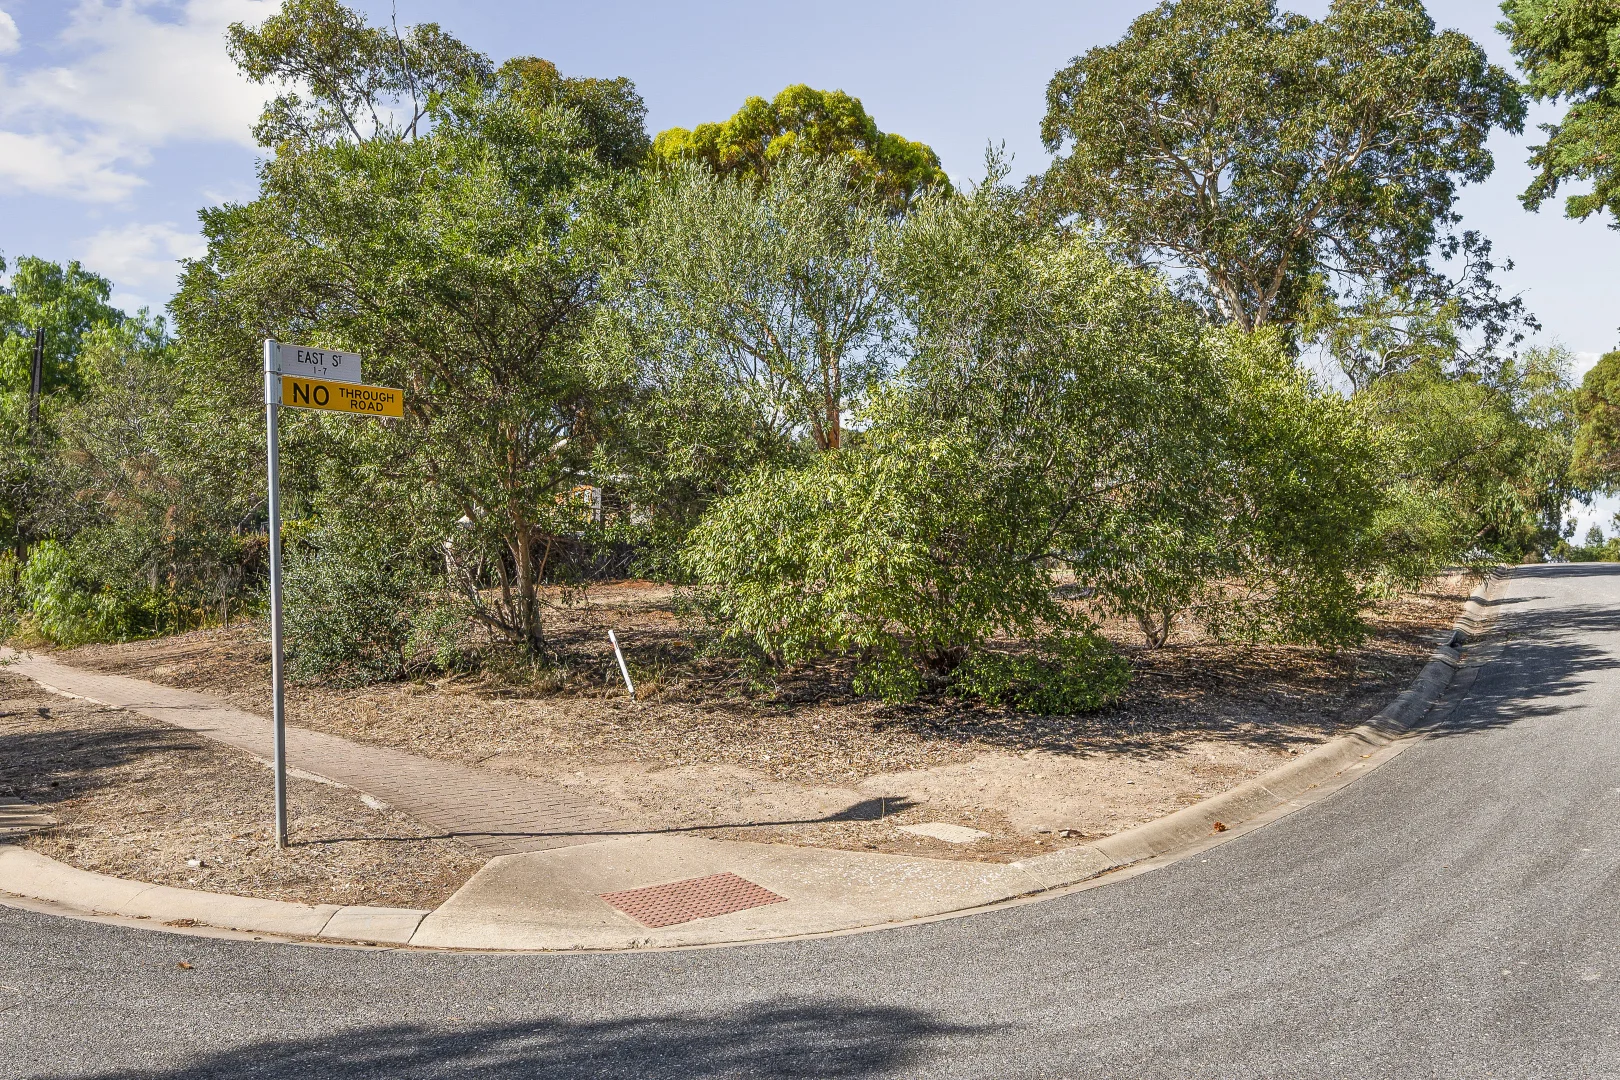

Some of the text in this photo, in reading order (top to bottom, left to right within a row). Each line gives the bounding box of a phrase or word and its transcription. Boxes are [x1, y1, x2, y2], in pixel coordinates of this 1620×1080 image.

[297, 350, 325, 366] EAST
[313, 367, 328, 375] 1-7
[293, 382, 394, 406] NO THROUGH
[350, 399, 384, 412] ROAD
